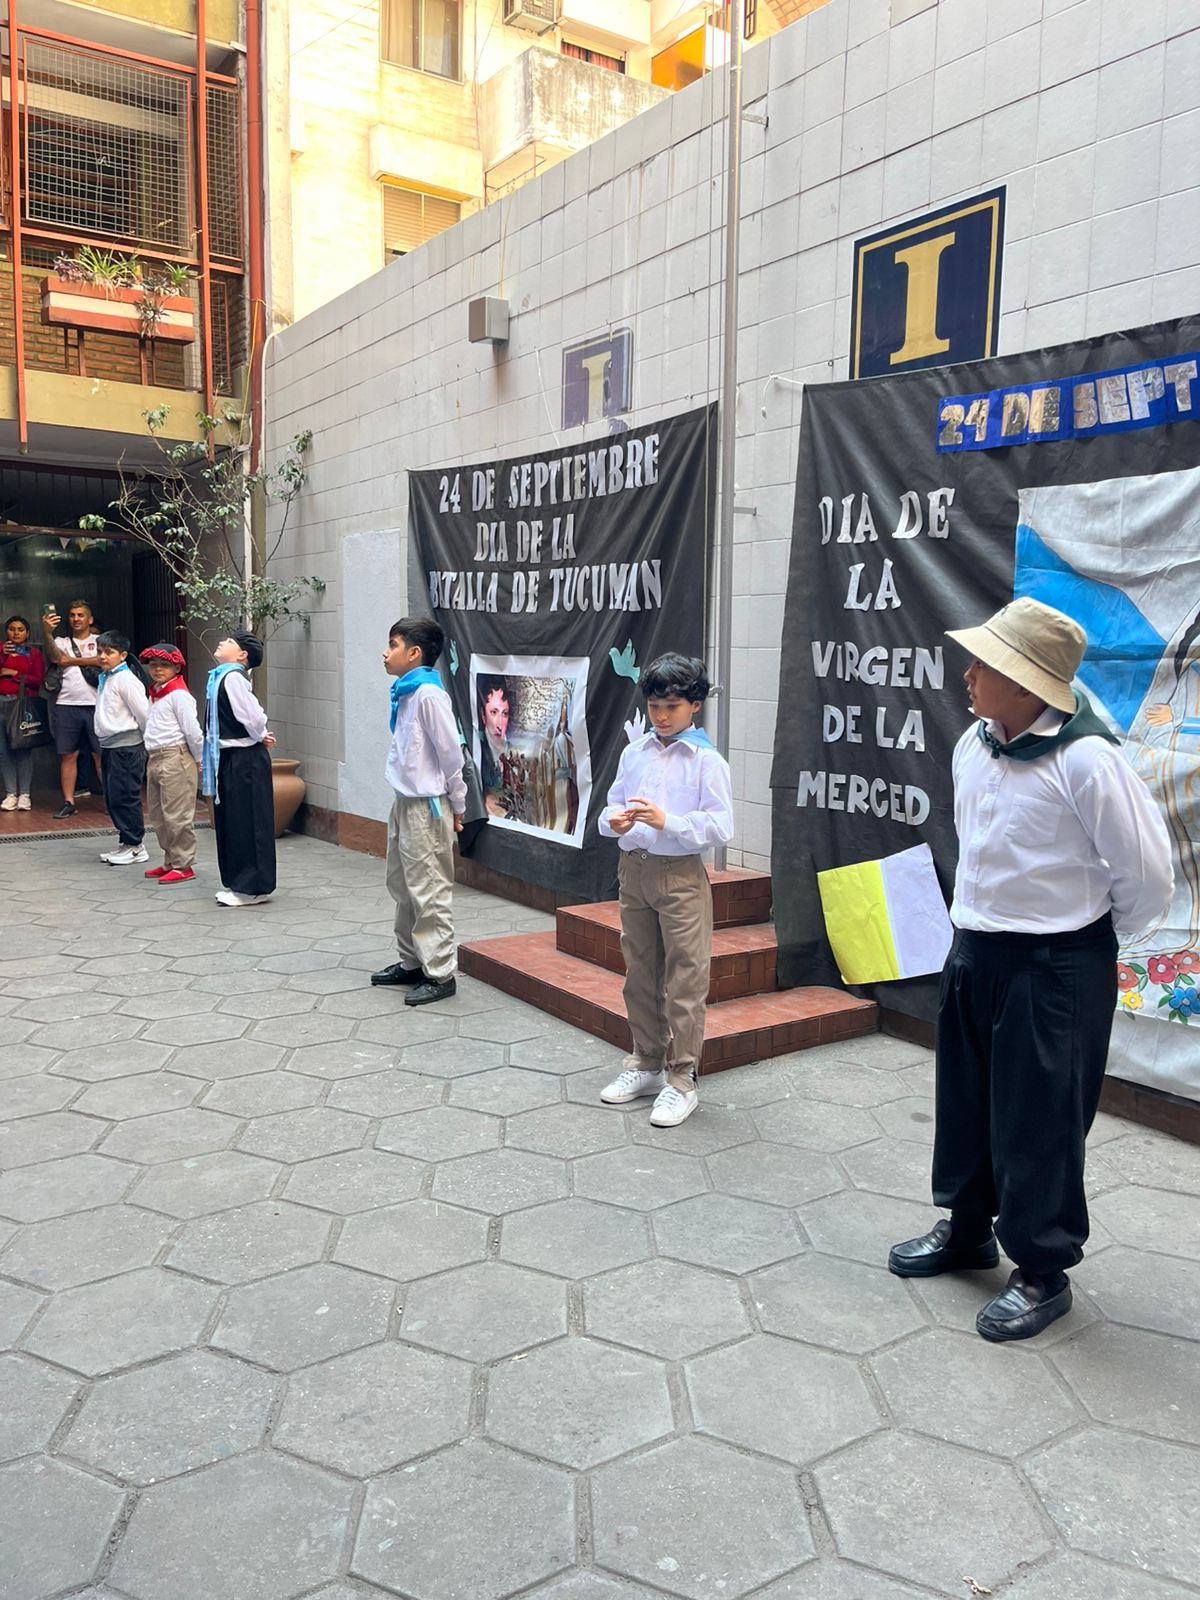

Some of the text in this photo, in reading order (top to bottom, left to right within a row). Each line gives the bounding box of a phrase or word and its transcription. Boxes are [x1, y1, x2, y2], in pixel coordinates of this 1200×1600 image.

[889, 231, 957, 366] I
[938, 359, 1198, 446] 24 DE SEPT
[439, 433, 660, 514] 24 DE SEPTIEMBRE
[473, 513, 576, 563] DIA DE LA
[818, 487, 956, 545] DIA DE
[510, 571, 540, 613] DE
[549, 559, 662, 612] TUCUMAN
[843, 558, 902, 612] LA
[811, 641, 945, 690] VIRGEN
[823, 704, 926, 753] DE LA
[797, 771, 931, 827] MERCED
